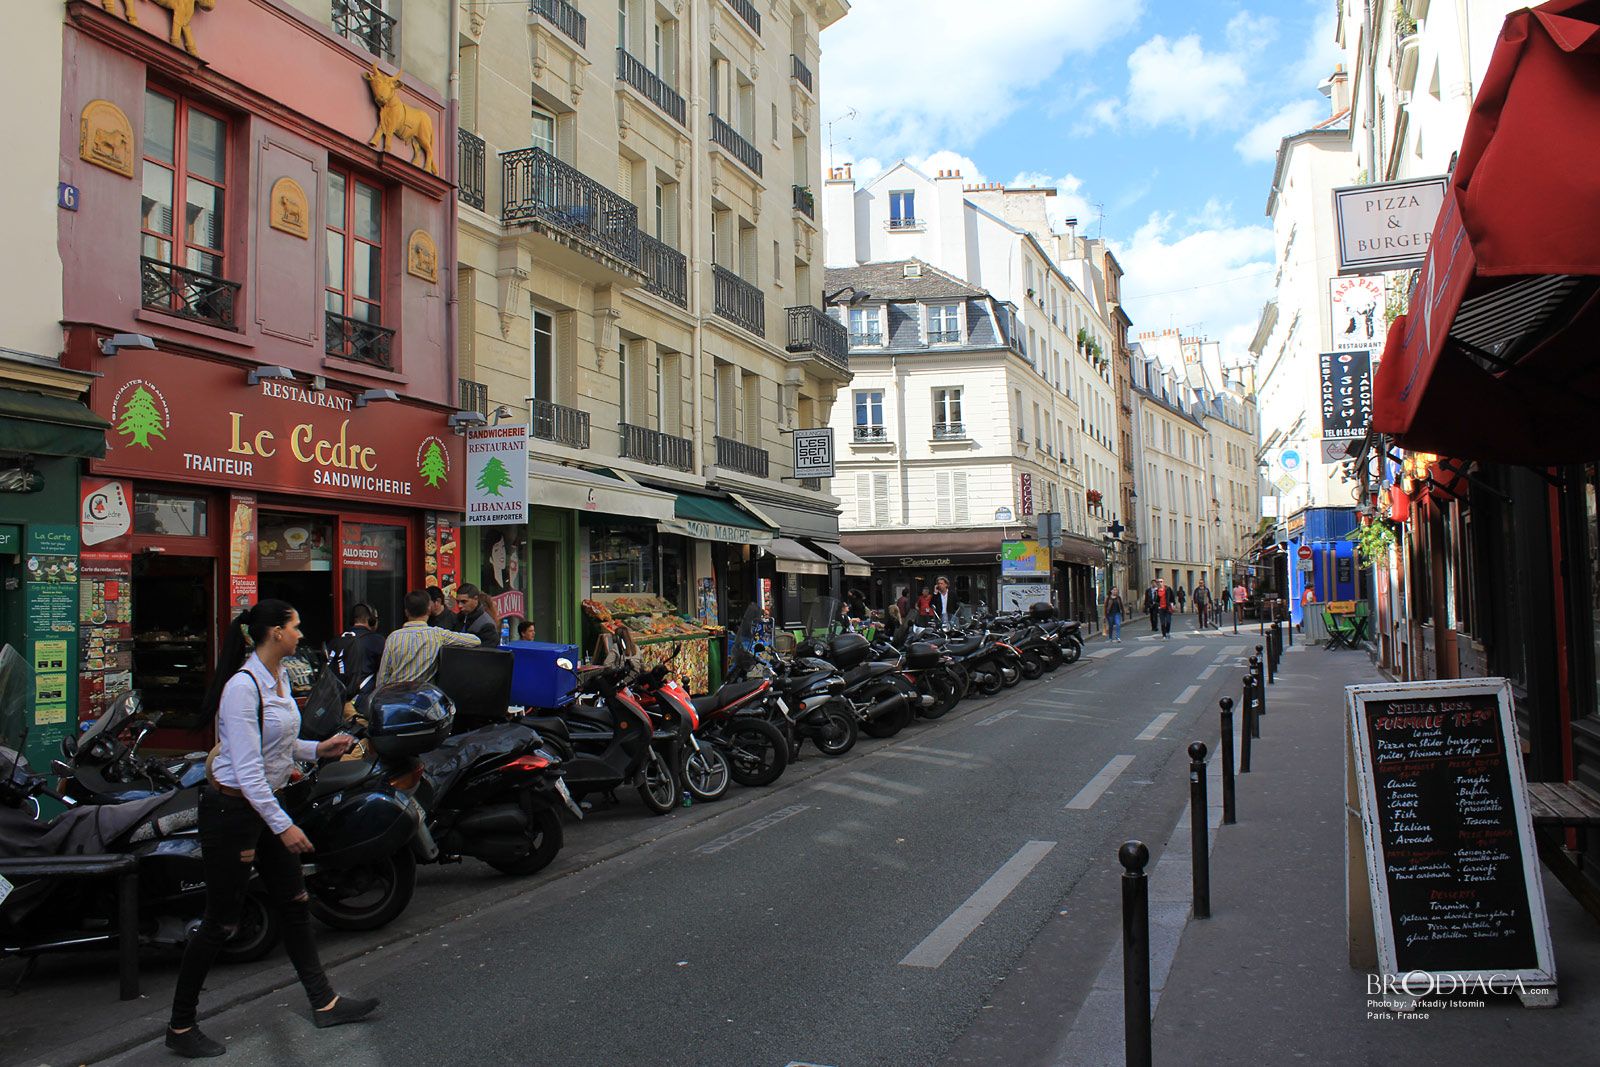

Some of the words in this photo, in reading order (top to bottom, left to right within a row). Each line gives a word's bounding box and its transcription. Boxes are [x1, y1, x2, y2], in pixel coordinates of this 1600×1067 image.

[64, 186, 75, 207] 6
[1365, 195, 1420, 212] PIZZA
[1387, 214, 1402, 229] &
[1358, 231, 1433, 252] BURGER
[1333, 279, 1355, 303] CASA
[1358, 278, 1383, 300] PEPE
[1337, 341, 1382, 350] RESTAURANT
[1320, 355, 1334, 419] RESTAURANT
[262, 381, 353, 412] RESTAURANT
[1359, 372, 1371, 426] JAPONAIS
[468, 427, 525, 440] SANDWICHERIE
[1324, 428, 1336, 437] TEL
[1335, 428, 1343, 436] 01
[1343, 428, 1350, 436] 55
[1350, 428, 1358, 436] 42
[1357, 428, 1365, 436] 02
[228, 411, 276, 458] Le
[290, 419, 378, 472] Cedre
[469, 440, 525, 453] RESTAURANT
[183, 453, 253, 477] TRAITEUR
[313, 469, 412, 496] SANDWICHERIE
[1022, 479, 1032, 514] VOLCAN
[470, 501, 522, 513] LIBANAIS
[492, 513, 523, 521] EMPORTER
[34, 531, 45, 540] La
[47, 531, 72, 541] Carte
[687, 521, 710, 538] MON
[714, 524, 751, 544] MARCHE
[342, 548, 358, 557] ALLO
[359, 548, 379, 559] RESTO
[899, 557, 951, 566] Restaurant
[503, 593, 521, 613] KIWI
[1387, 702, 1437, 715] STELLA
[1440, 701, 1472, 712] ROSA
[1374, 714, 1447, 731] FORMULE
[1422, 728, 1442, 737] midi
[1377, 739, 1405, 750] Pizza
[1446, 735, 1478, 750] burger
[1444, 747, 1453, 756] et
[1387, 779, 1417, 789] Classic
[1456, 774, 1491, 787] Funghi
[1391, 790, 1419, 799] Bacon
[1460, 785, 1490, 799] Bufala
[1391, 800, 1419, 808] Cheese
[1394, 809, 1417, 819] Fish
[1393, 821, 1431, 832] Italian
[1465, 817, 1501, 825] Toscana
[1395, 834, 1434, 844] Avocado
[1462, 921, 1491, 929] Nutella
